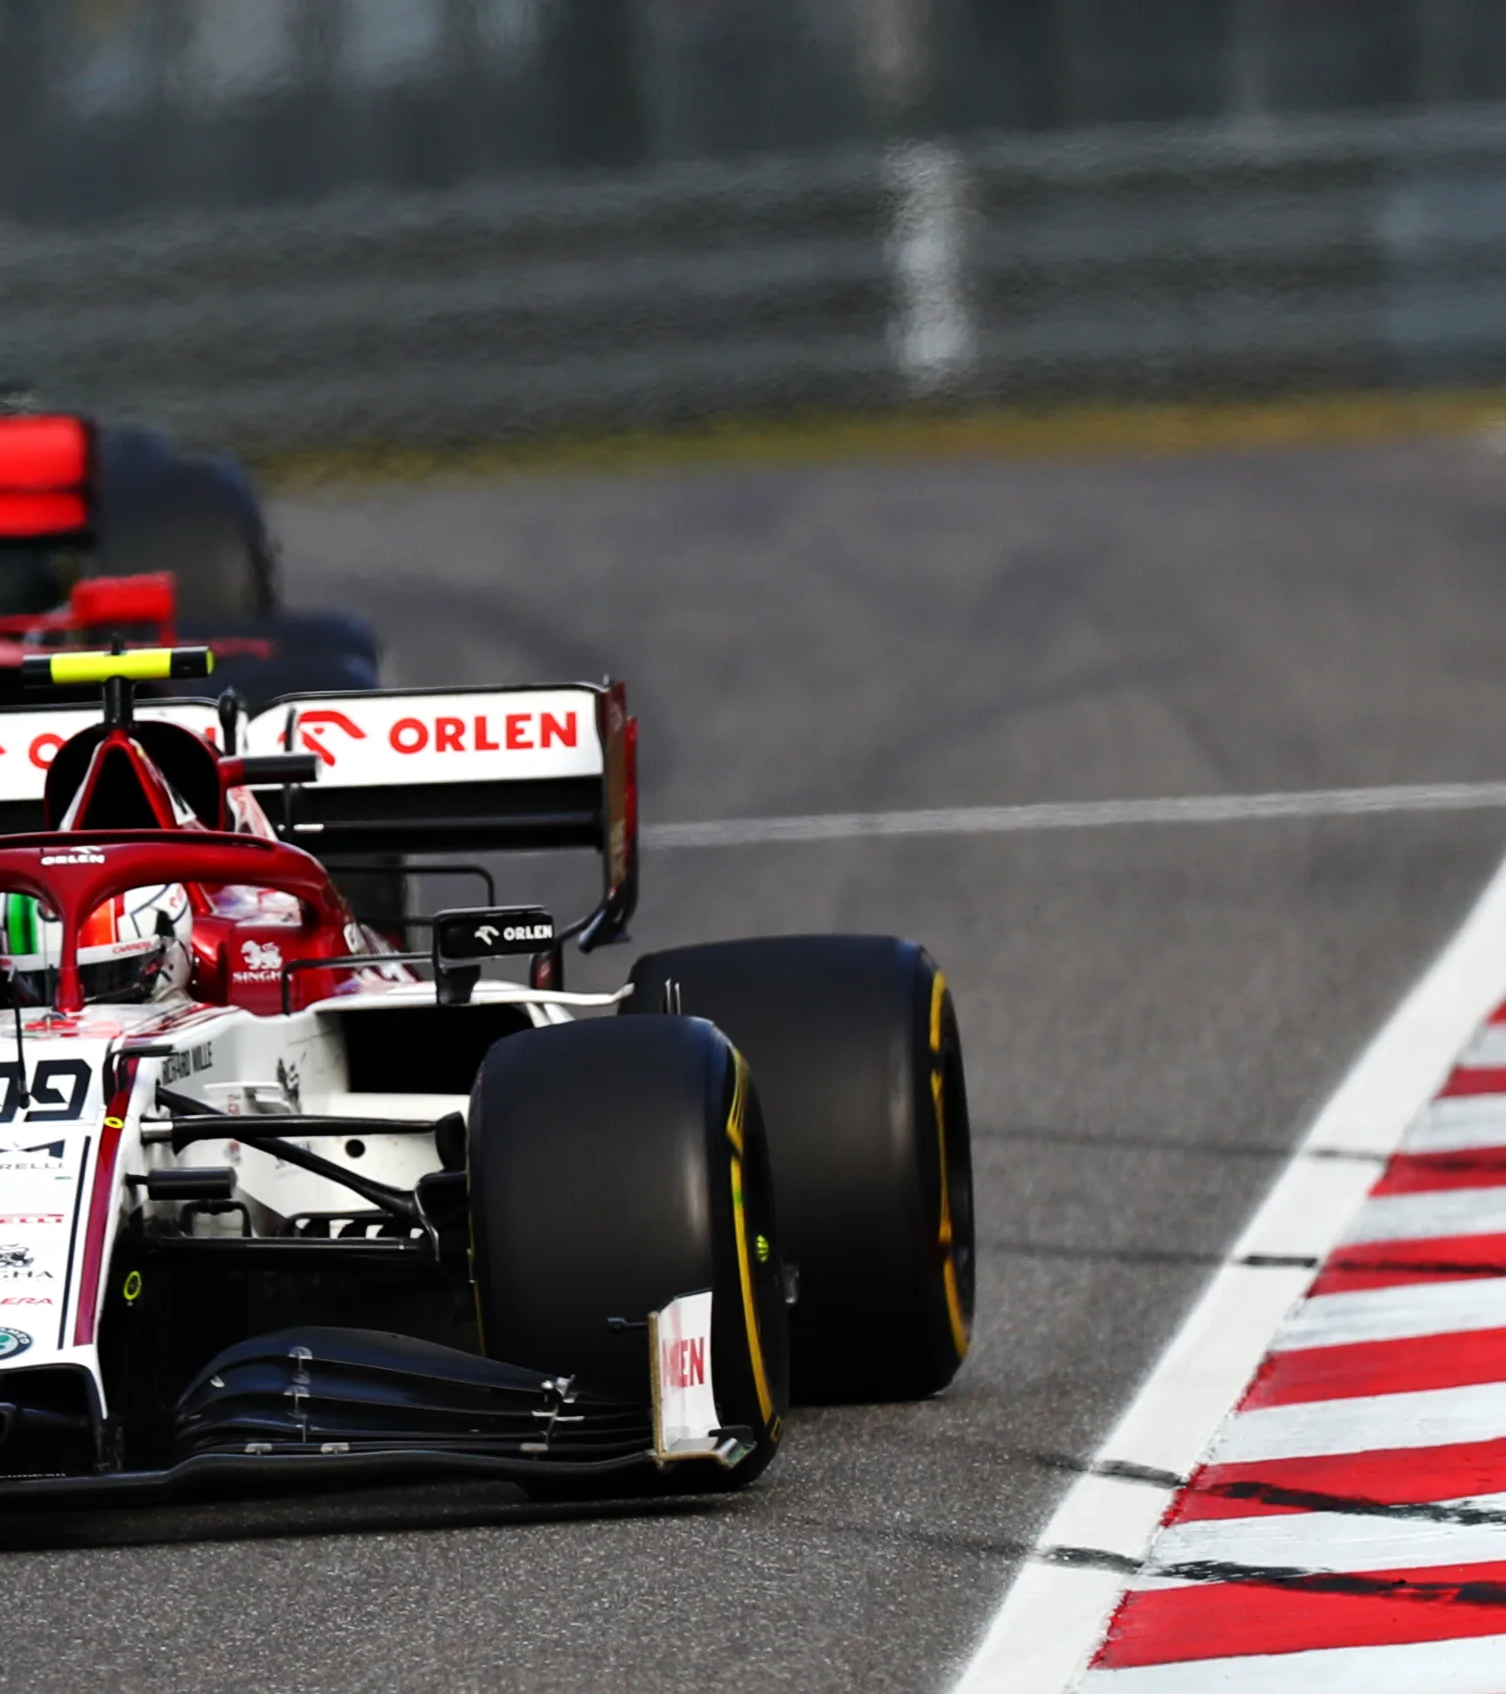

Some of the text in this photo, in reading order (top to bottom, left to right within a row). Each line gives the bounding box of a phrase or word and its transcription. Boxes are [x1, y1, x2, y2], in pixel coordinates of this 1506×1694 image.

[390, 711, 577, 754] ORLEN
[41, 854, 105, 866] ORLEN
[503, 924, 552, 941] ORLEN
